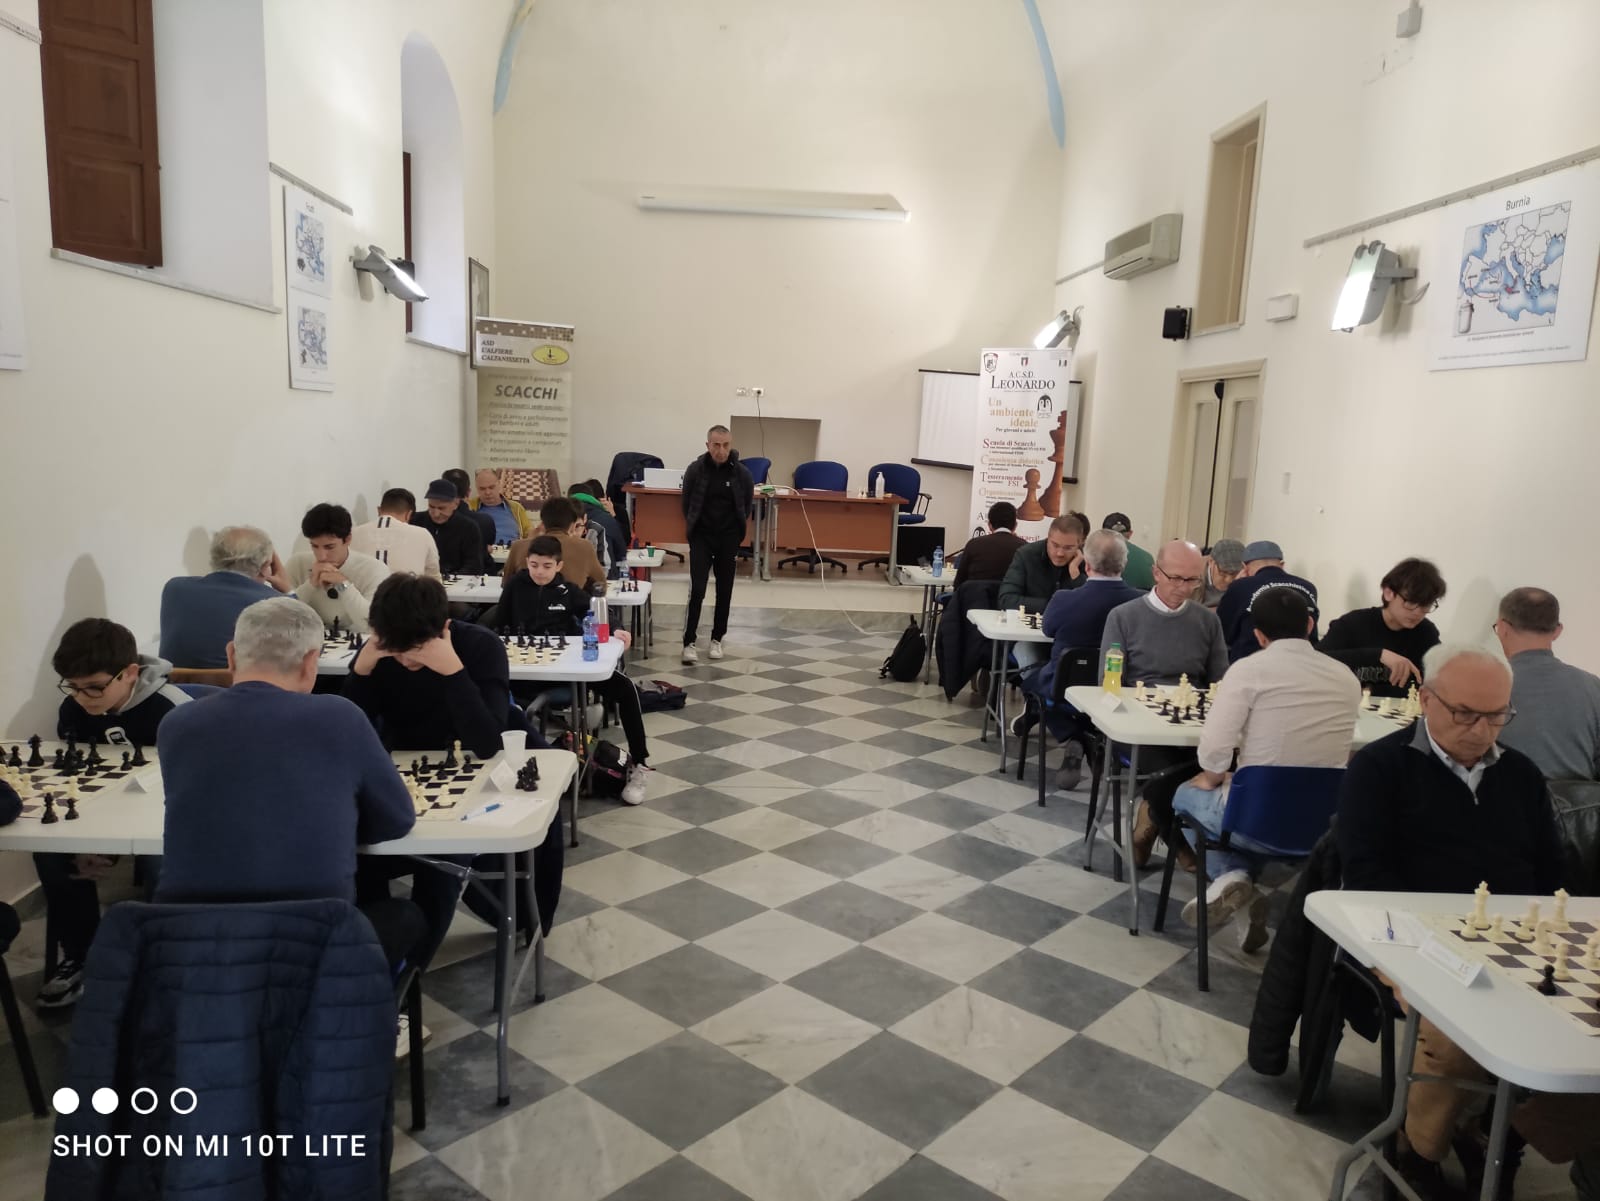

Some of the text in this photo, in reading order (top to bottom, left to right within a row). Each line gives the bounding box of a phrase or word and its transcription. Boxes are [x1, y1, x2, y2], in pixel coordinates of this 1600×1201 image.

[1505, 194, 1531, 211] Burnia
[991, 376, 1055, 390] LEONARDO
[495, 385, 558, 400] SCACCHI
[990, 408, 1034, 417] ambiente
[1010, 418, 1039, 427] ideale
